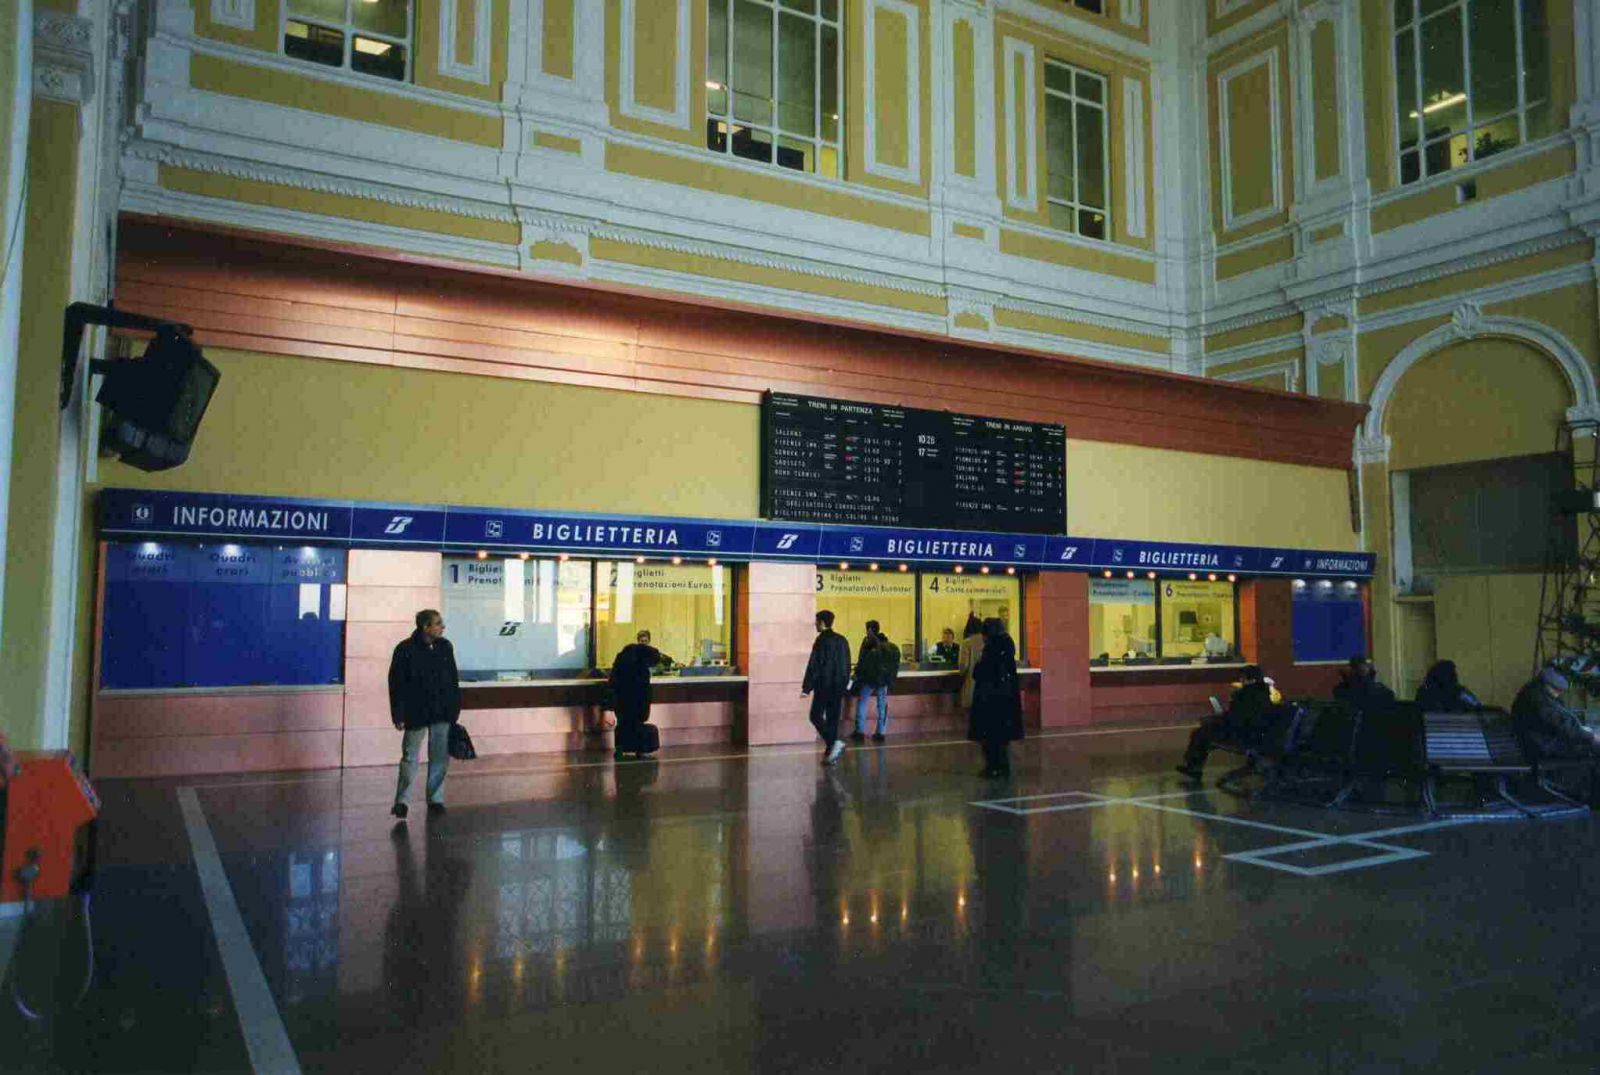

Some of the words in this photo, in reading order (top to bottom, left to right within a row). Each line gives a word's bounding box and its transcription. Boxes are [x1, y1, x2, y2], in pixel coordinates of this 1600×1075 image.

[808, 400, 827, 410] TRENI
[831, 403, 838, 411] IN
[841, 404, 873, 415] PARTENZA
[986, 421, 1002, 429] TRENI
[1004, 423, 1011, 431] IN
[1013, 424, 1033, 433] ARRIVO
[173, 506, 329, 531] INFORMAZIONI
[533, 523, 679, 545] BIGLIETTERIA
[887, 539, 993, 557] BIGLIETTERIA
[1139, 551, 1219, 566] BIGLIETTERIA
[1316, 558, 1369, 571] INFORMAZIONI
[450, 564, 458, 583] 1
[816, 574, 824, 592] 3
[930, 576, 939, 593] 4
[1166, 584, 1174, 598] 6
